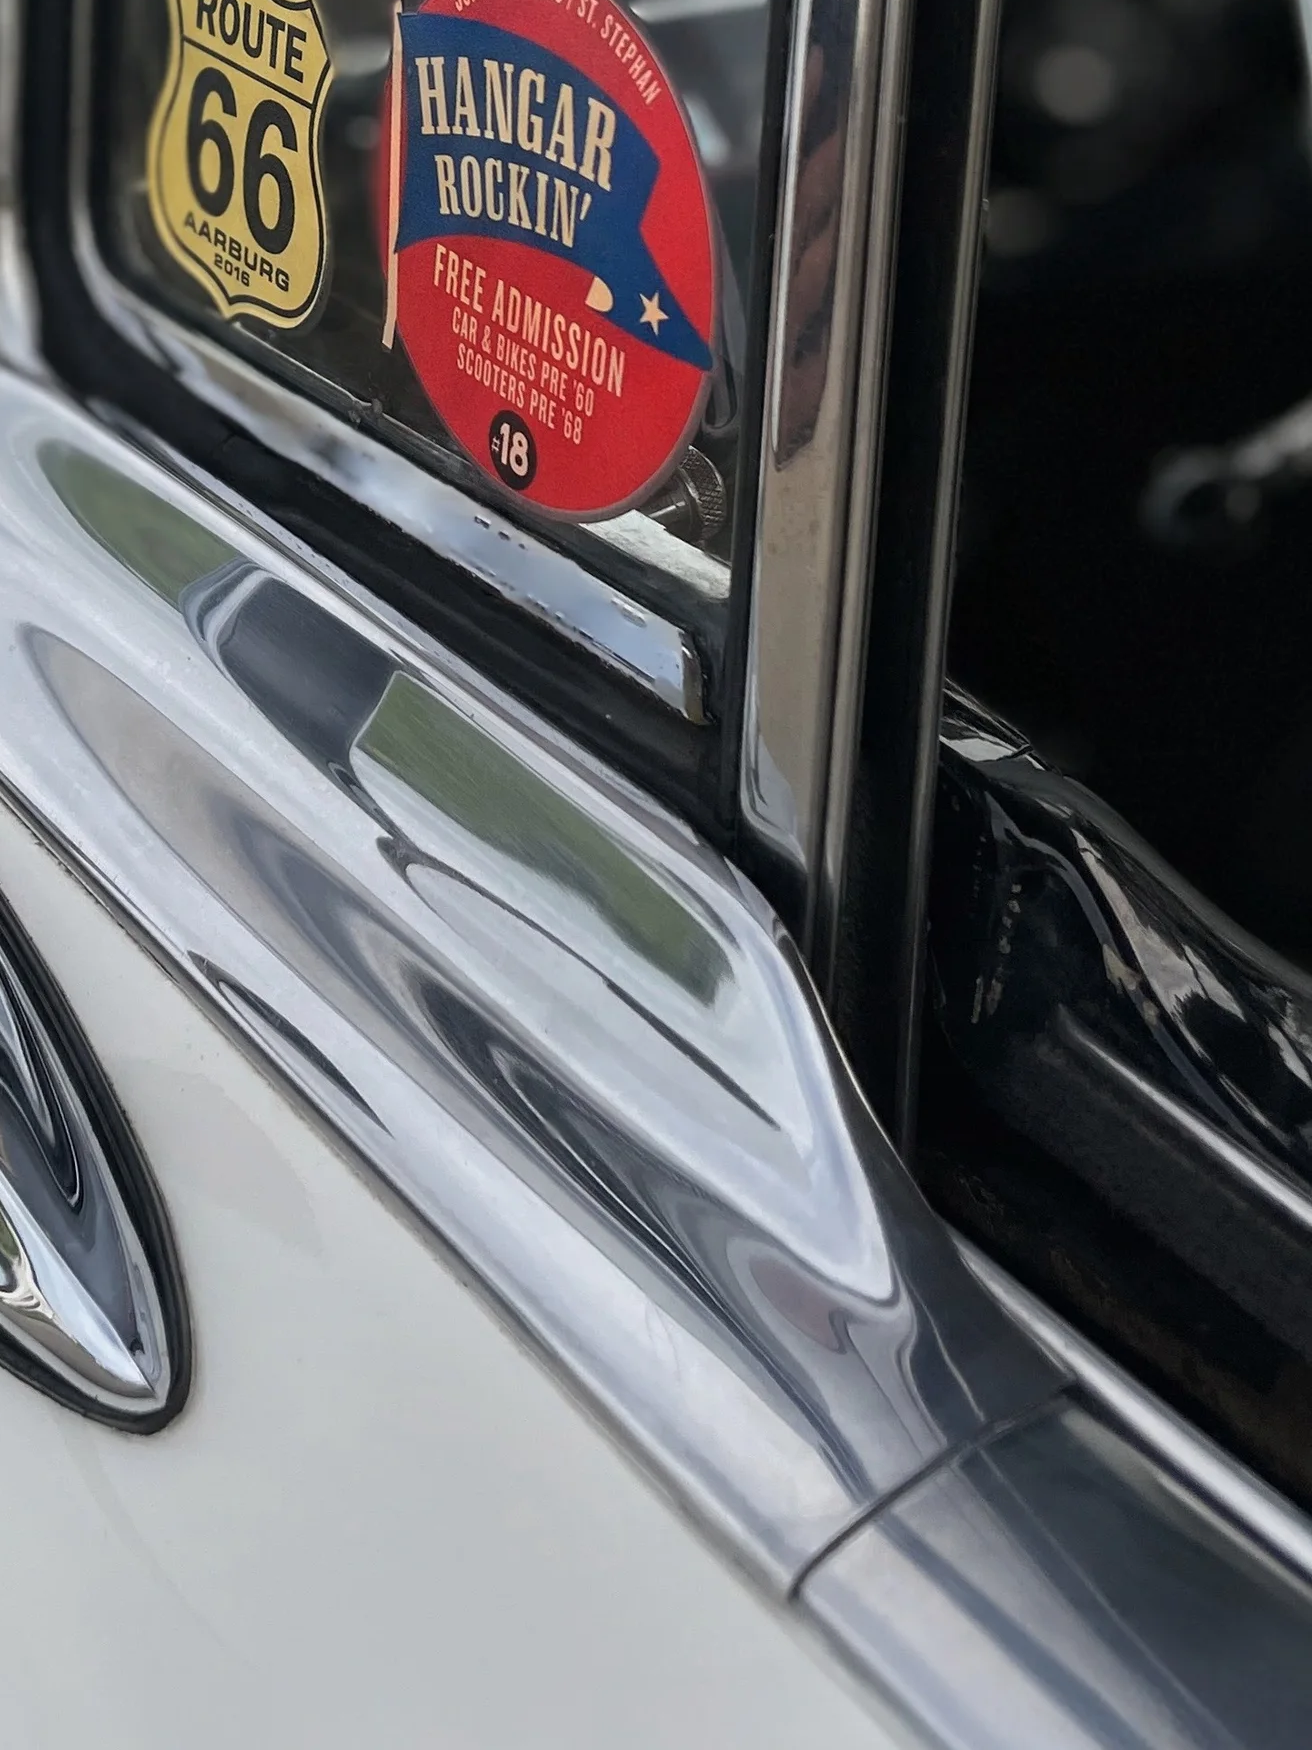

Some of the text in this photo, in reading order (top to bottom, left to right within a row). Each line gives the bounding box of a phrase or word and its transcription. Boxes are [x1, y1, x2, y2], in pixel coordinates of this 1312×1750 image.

[600, 14, 662, 105] STEPHAN
[187, 66, 299, 255] 66
[414, 56, 617, 192] HANGAR
[433, 154, 592, 248] ROCKIN'
[184, 210, 290, 292] AARBURG
[214, 252, 251, 288] 2016
[434, 243, 626, 398] FREE ADMISSION
[452, 306, 594, 417] CAR & BIKES PRE '60
[457, 342, 583, 445] SCOOTERS PRE '68
[491, 422, 529, 477] #18
